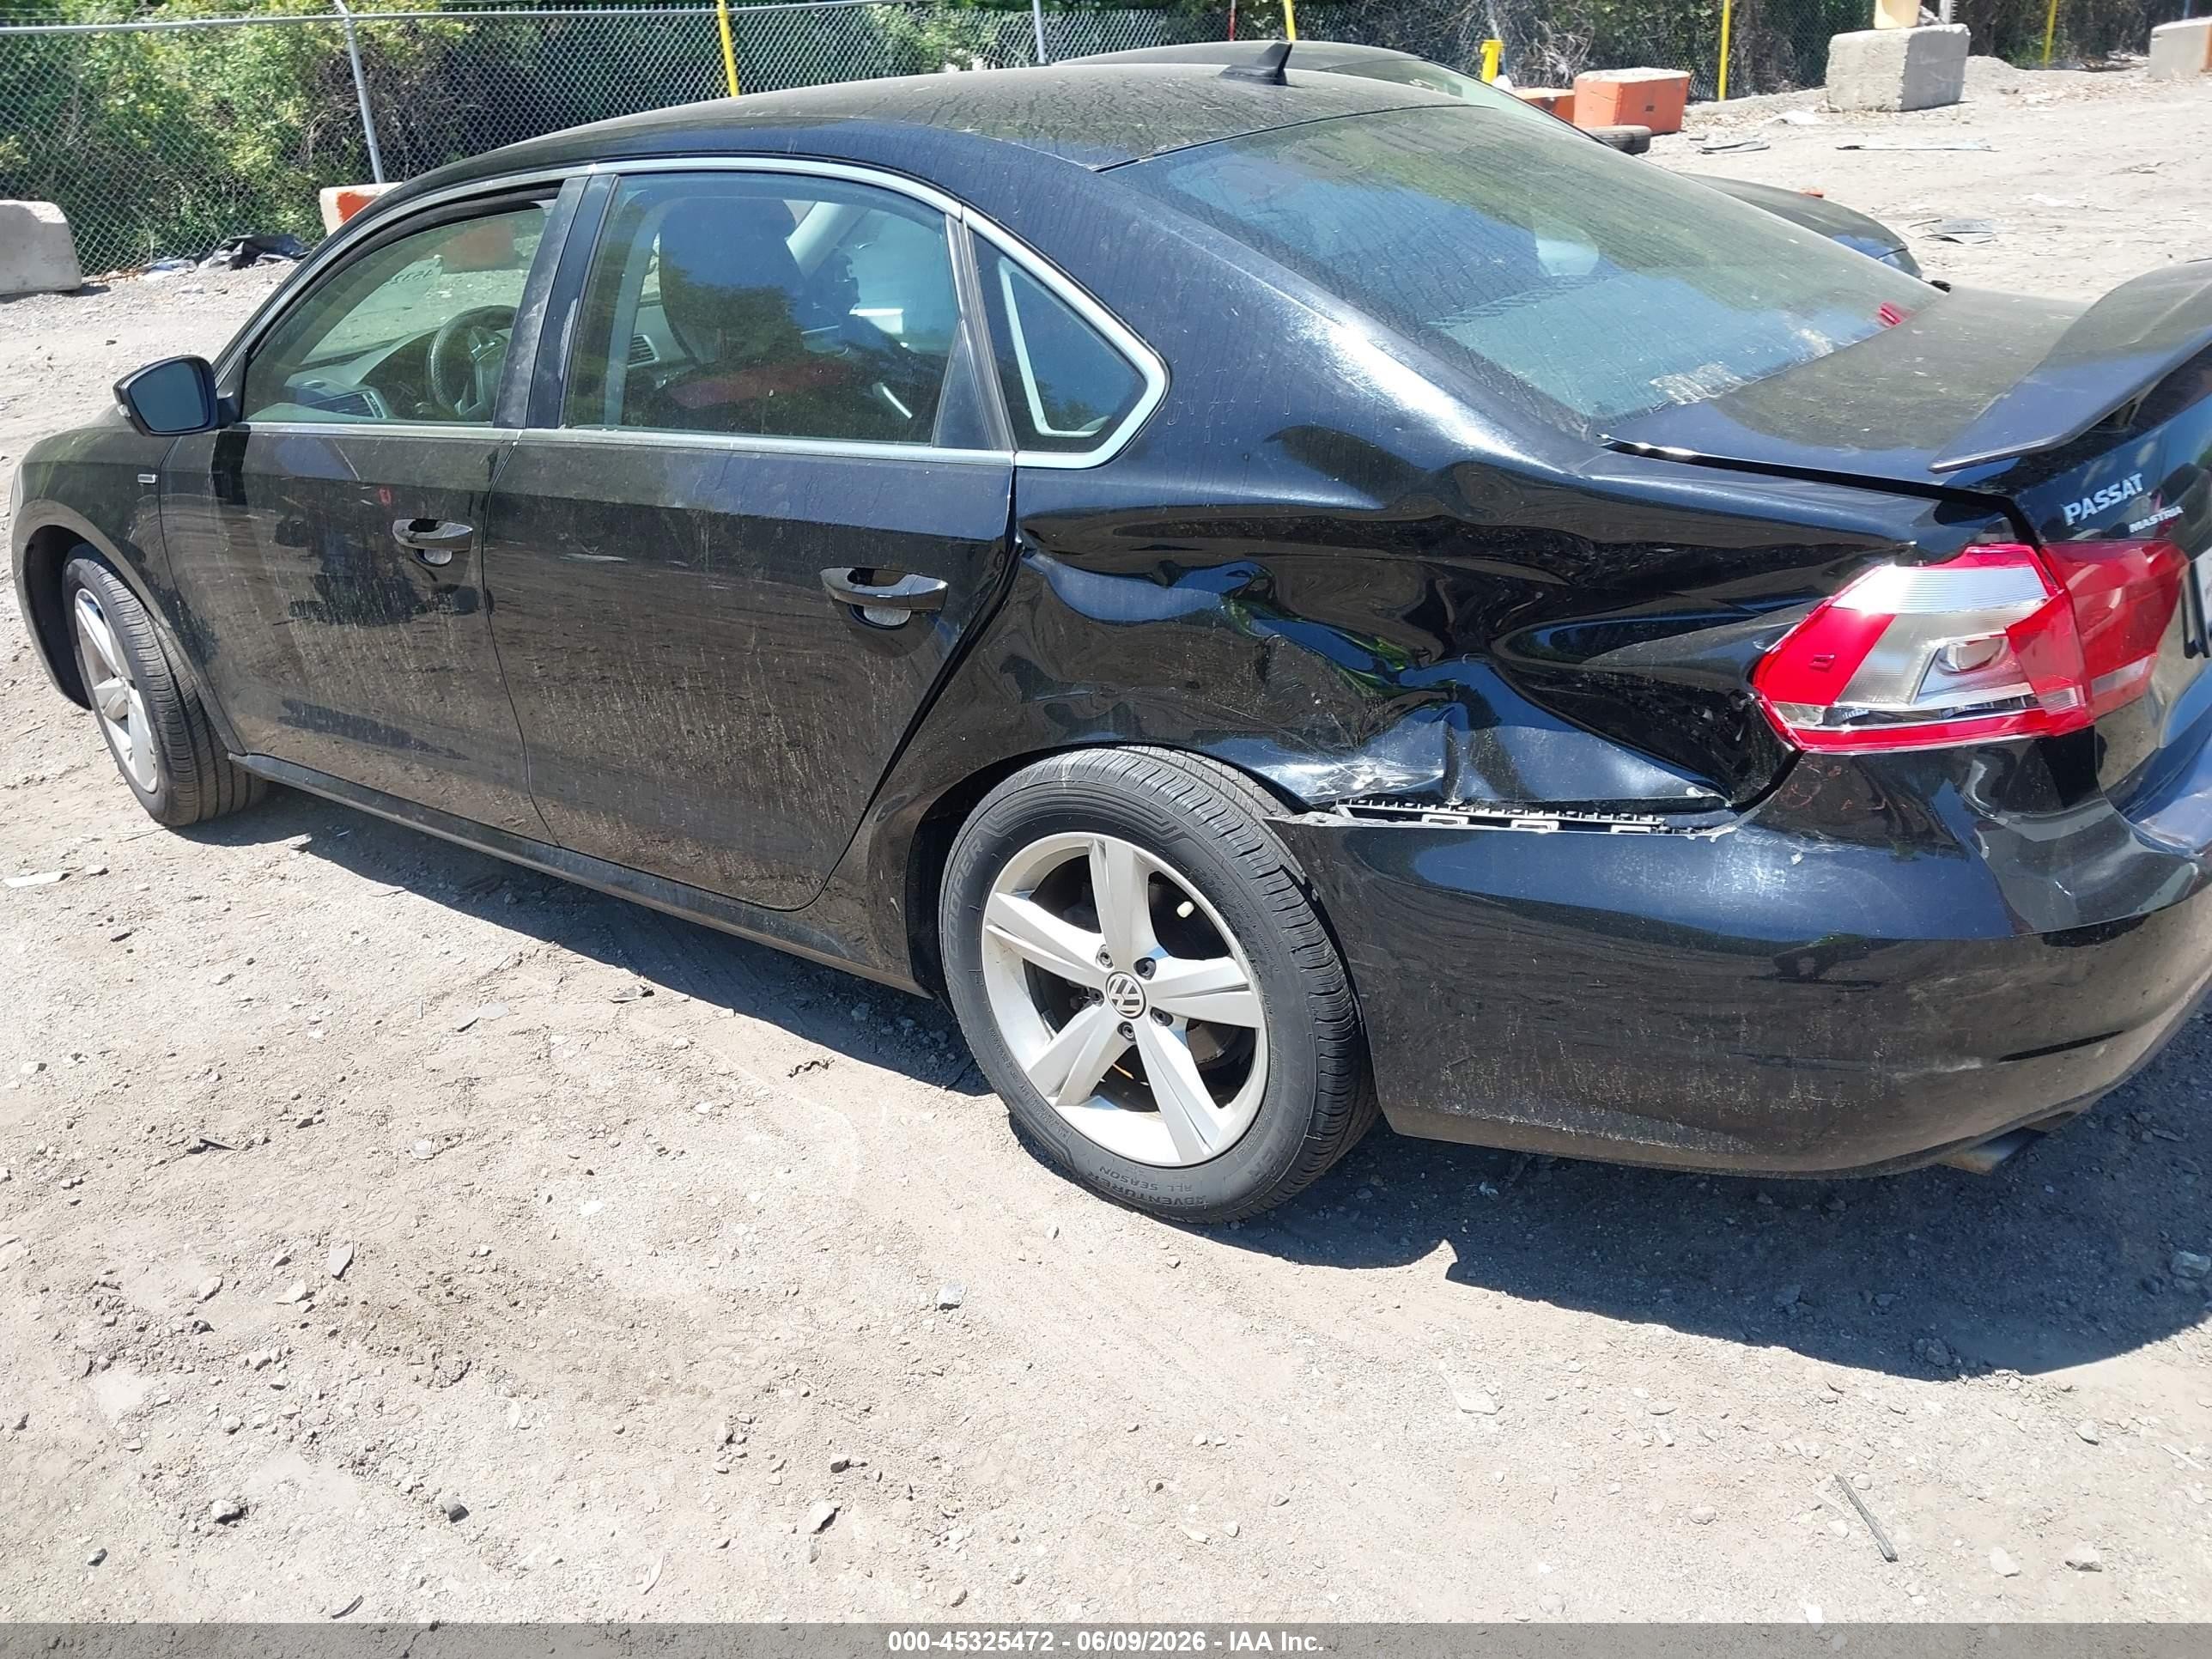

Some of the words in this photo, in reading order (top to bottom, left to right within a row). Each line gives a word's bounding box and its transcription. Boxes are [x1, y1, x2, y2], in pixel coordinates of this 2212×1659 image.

[2063, 472, 2143, 526] PASSAT
[947, 837, 984, 959] COOPER
[1087, 1171, 1209, 1208] ADVENTURER
[1099, 1165, 1159, 1191] SEASON
[1167, 1182, 1193, 1193] ALL
